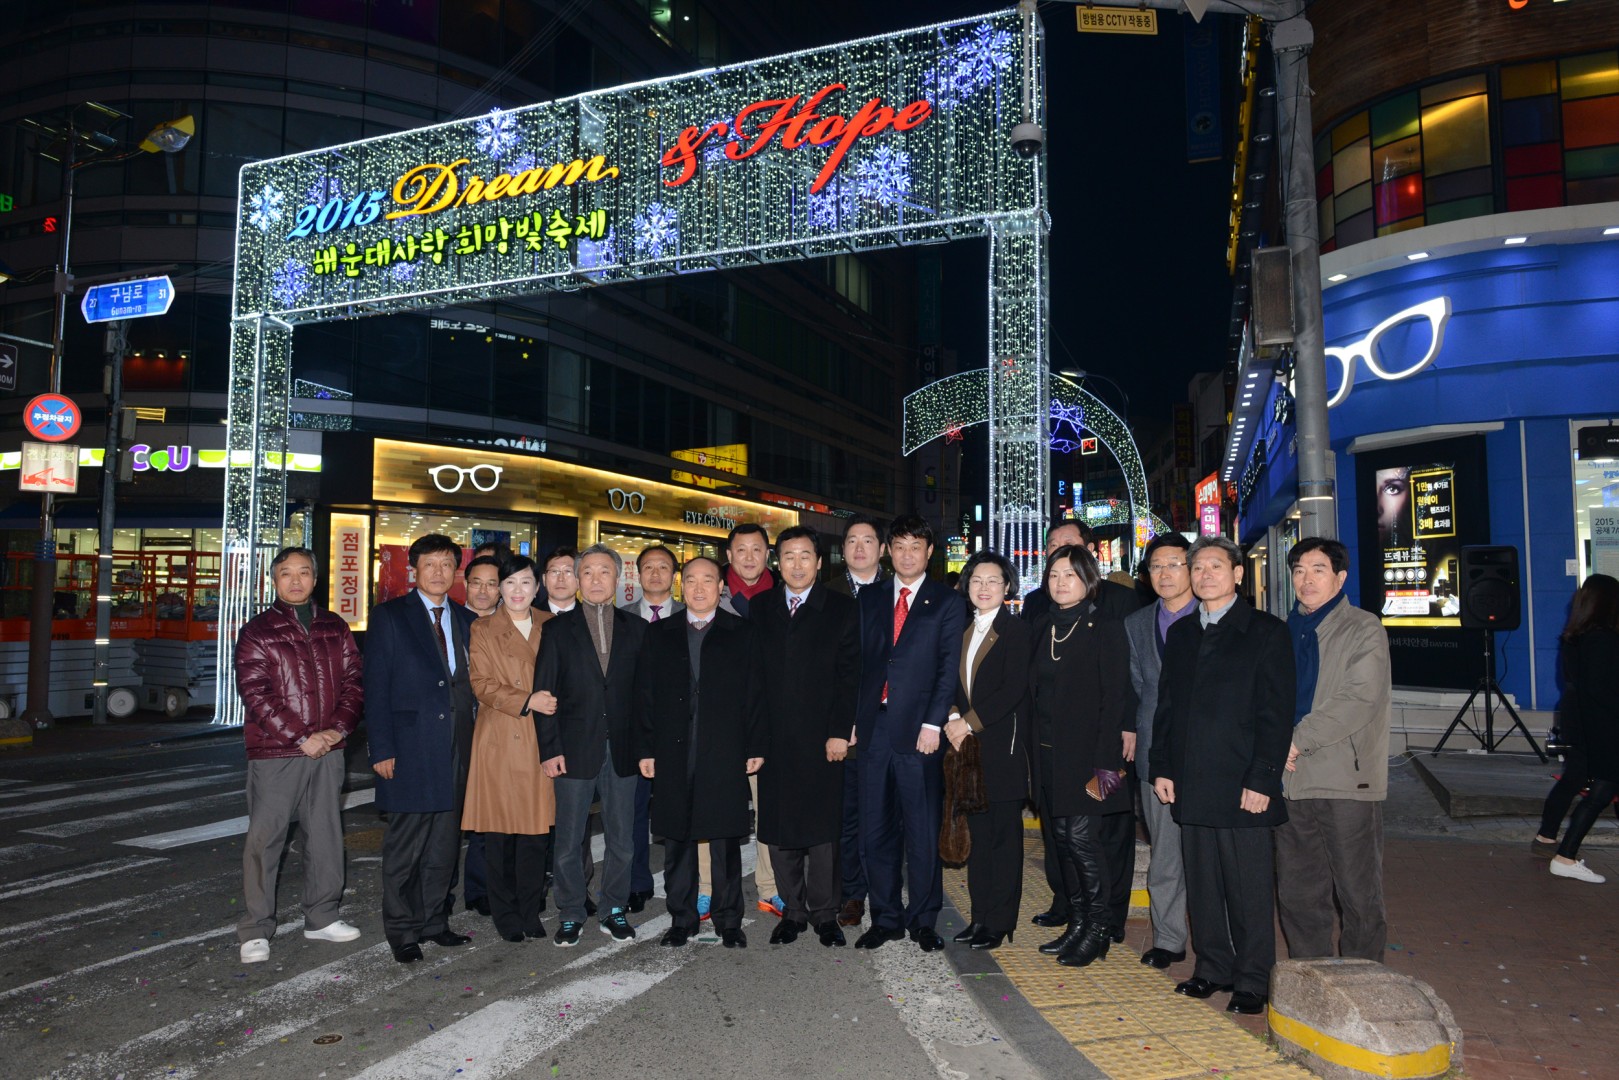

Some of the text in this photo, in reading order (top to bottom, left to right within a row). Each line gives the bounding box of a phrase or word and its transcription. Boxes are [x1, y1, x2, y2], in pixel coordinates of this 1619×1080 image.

[1083, 13, 1151, 28] 방범용 CCTV 작동중
[287, 83, 932, 240] 2015 Dream & Hope
[313, 209, 608, 277] 해운대사랑 희망빛축제
[110, 284, 143, 303] 구남로
[158, 288, 166, 299] 31
[89, 298, 97, 308] 27
[111, 305, 142, 316] Gunam-ro
[33, 412, 73, 423] 주정차금지
[1083, 439, 1095, 450] PC
[128, 443, 192, 472] CU
[1058, 480, 1065, 495] PC
[686, 510, 703, 525] EYE
[1595, 518, 1614, 526] 2015
[340, 532, 360, 617] 점포정리
